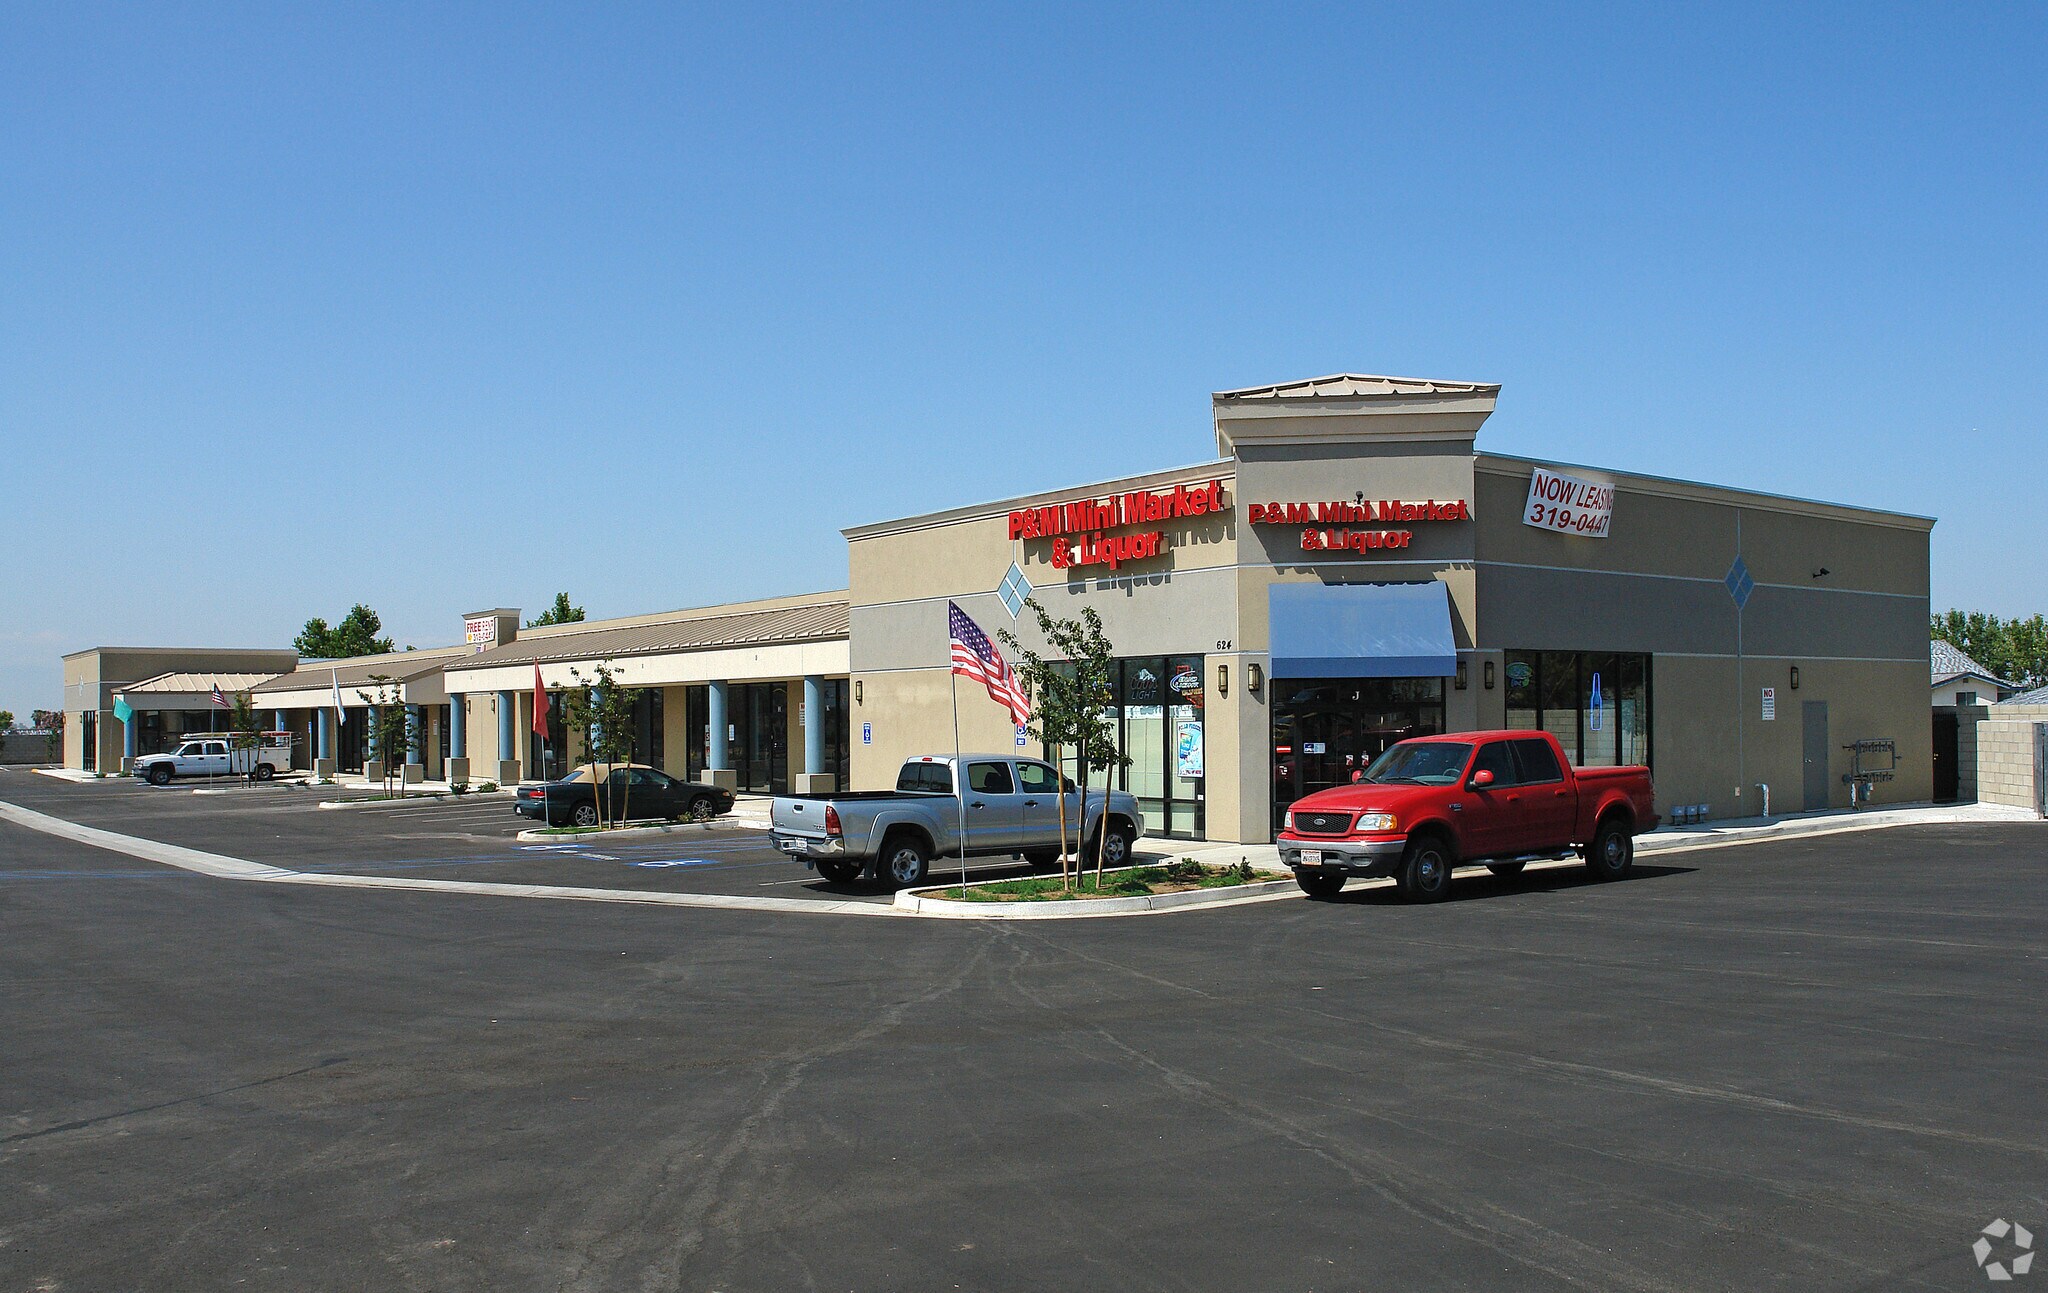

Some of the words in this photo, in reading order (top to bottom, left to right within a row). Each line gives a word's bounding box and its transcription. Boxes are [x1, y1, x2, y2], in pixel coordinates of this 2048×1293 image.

[1533, 474, 1577, 504] NOW
[1009, 505, 1065, 540] P&M
[1067, 495, 1121, 533] Mini
[1125, 479, 1222, 524] Market
[1249, 502, 1309, 524] P&M
[1318, 500, 1373, 522] Mini
[1379, 499, 1468, 521] Market
[1530, 503, 1609, 533] 319-0447
[1052, 537, 1076, 569] &
[1080, 531, 1163, 571] Liquor
[1302, 528, 1323, 550] &
[1326, 528, 1412, 554] Liquor
[467, 622, 481, 633] FREE
[1216, 640, 1232, 650] 624
[1131, 690, 1156, 700] LIGHT
[1351, 691, 1360, 700] J
[1763, 689, 1773, 697] NO
